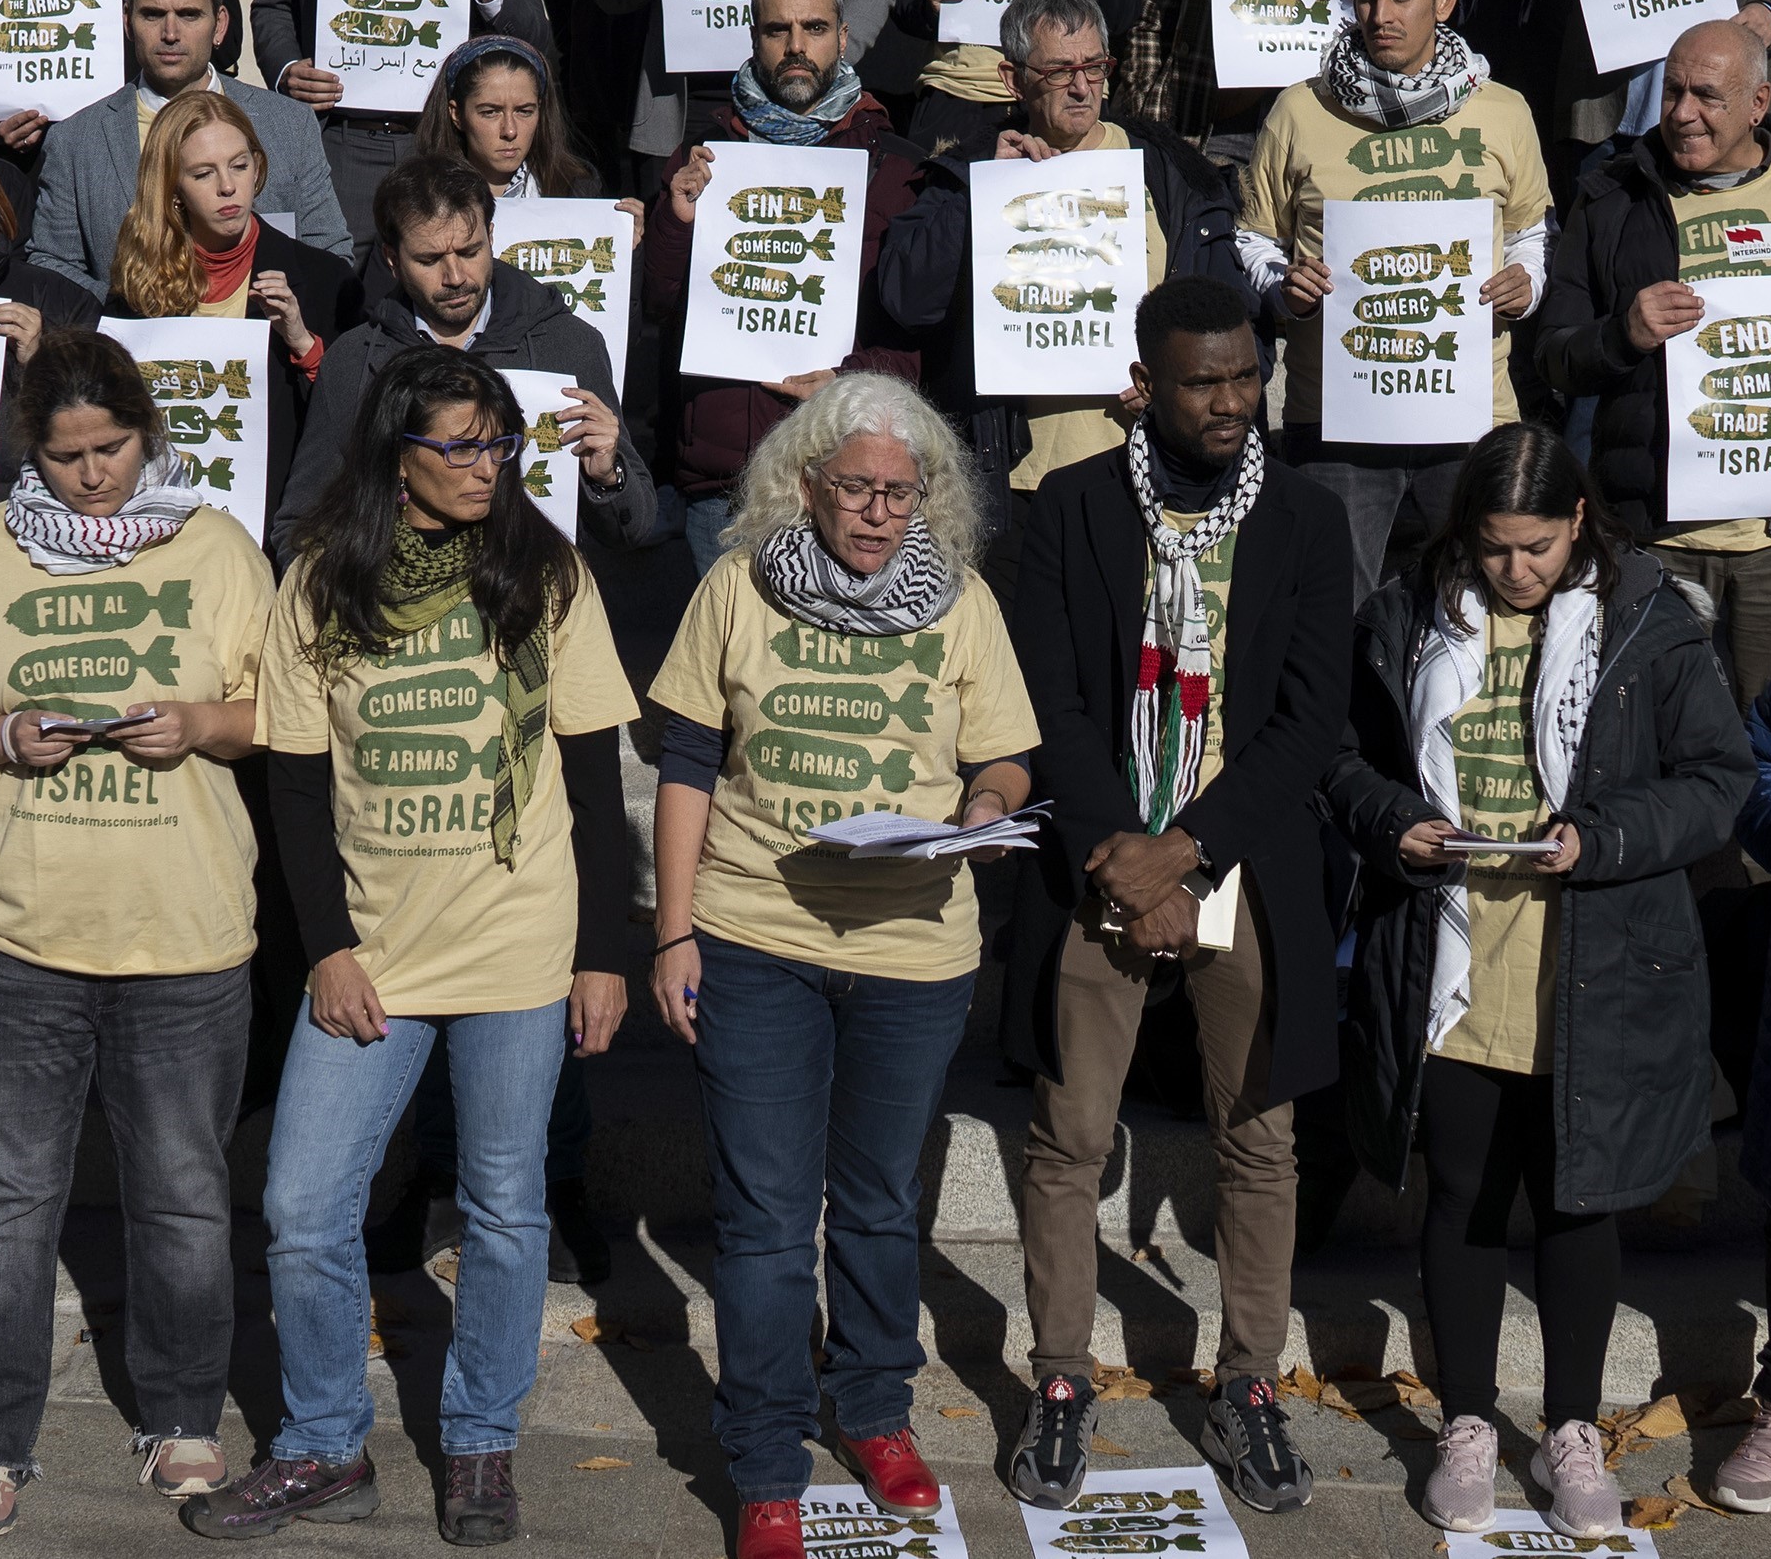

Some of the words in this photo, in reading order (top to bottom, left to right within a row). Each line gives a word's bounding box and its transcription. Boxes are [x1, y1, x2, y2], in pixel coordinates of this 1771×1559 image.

[1259, 5, 1299, 19] ARMAS
[8, 28, 58, 47] TRADE
[16, 57, 94, 83] ISRAEL
[328, 47, 406, 75] إسرائيل
[413, 57, 437, 78] مع
[1369, 135, 1414, 168] FIN
[1421, 136, 1439, 154] AL
[747, 194, 783, 219] FIN
[517, 247, 553, 271] FIN
[733, 240, 803, 255] COMERCIO
[743, 275, 788, 295] ARMAS
[1017, 285, 1074, 306] TRADE
[1362, 295, 1429, 319] COMERÇ
[721, 307, 734, 315] CON
[737, 306, 818, 337] ISRAEL
[1003, 324, 1022, 332] WITH
[1026, 320, 1115, 349] ISRAEL
[1354, 334, 1425, 357] D'ARMES
[1353, 371, 1368, 380] AMB
[1371, 369, 1456, 395] ISRAEL
[1712, 411, 1769, 433] TRADE
[1697, 451, 1715, 459] WITH
[35, 595, 93, 627] FIN
[104, 598, 127, 614] AL
[449, 618, 473, 639] AL
[862, 640, 883, 660] AL
[19, 656, 129, 687] COMERCIO
[369, 686, 477, 718] COMERCIO
[773, 695, 883, 721] COMERCIO
[388, 750, 458, 772] ARMAS
[760, 746, 781, 768] DE
[789, 749, 859, 780] ARMAS
[758, 797, 775, 811] CON
[802, 1520, 887, 1538] ARMAK
[1508, 1533, 1575, 1550] END
